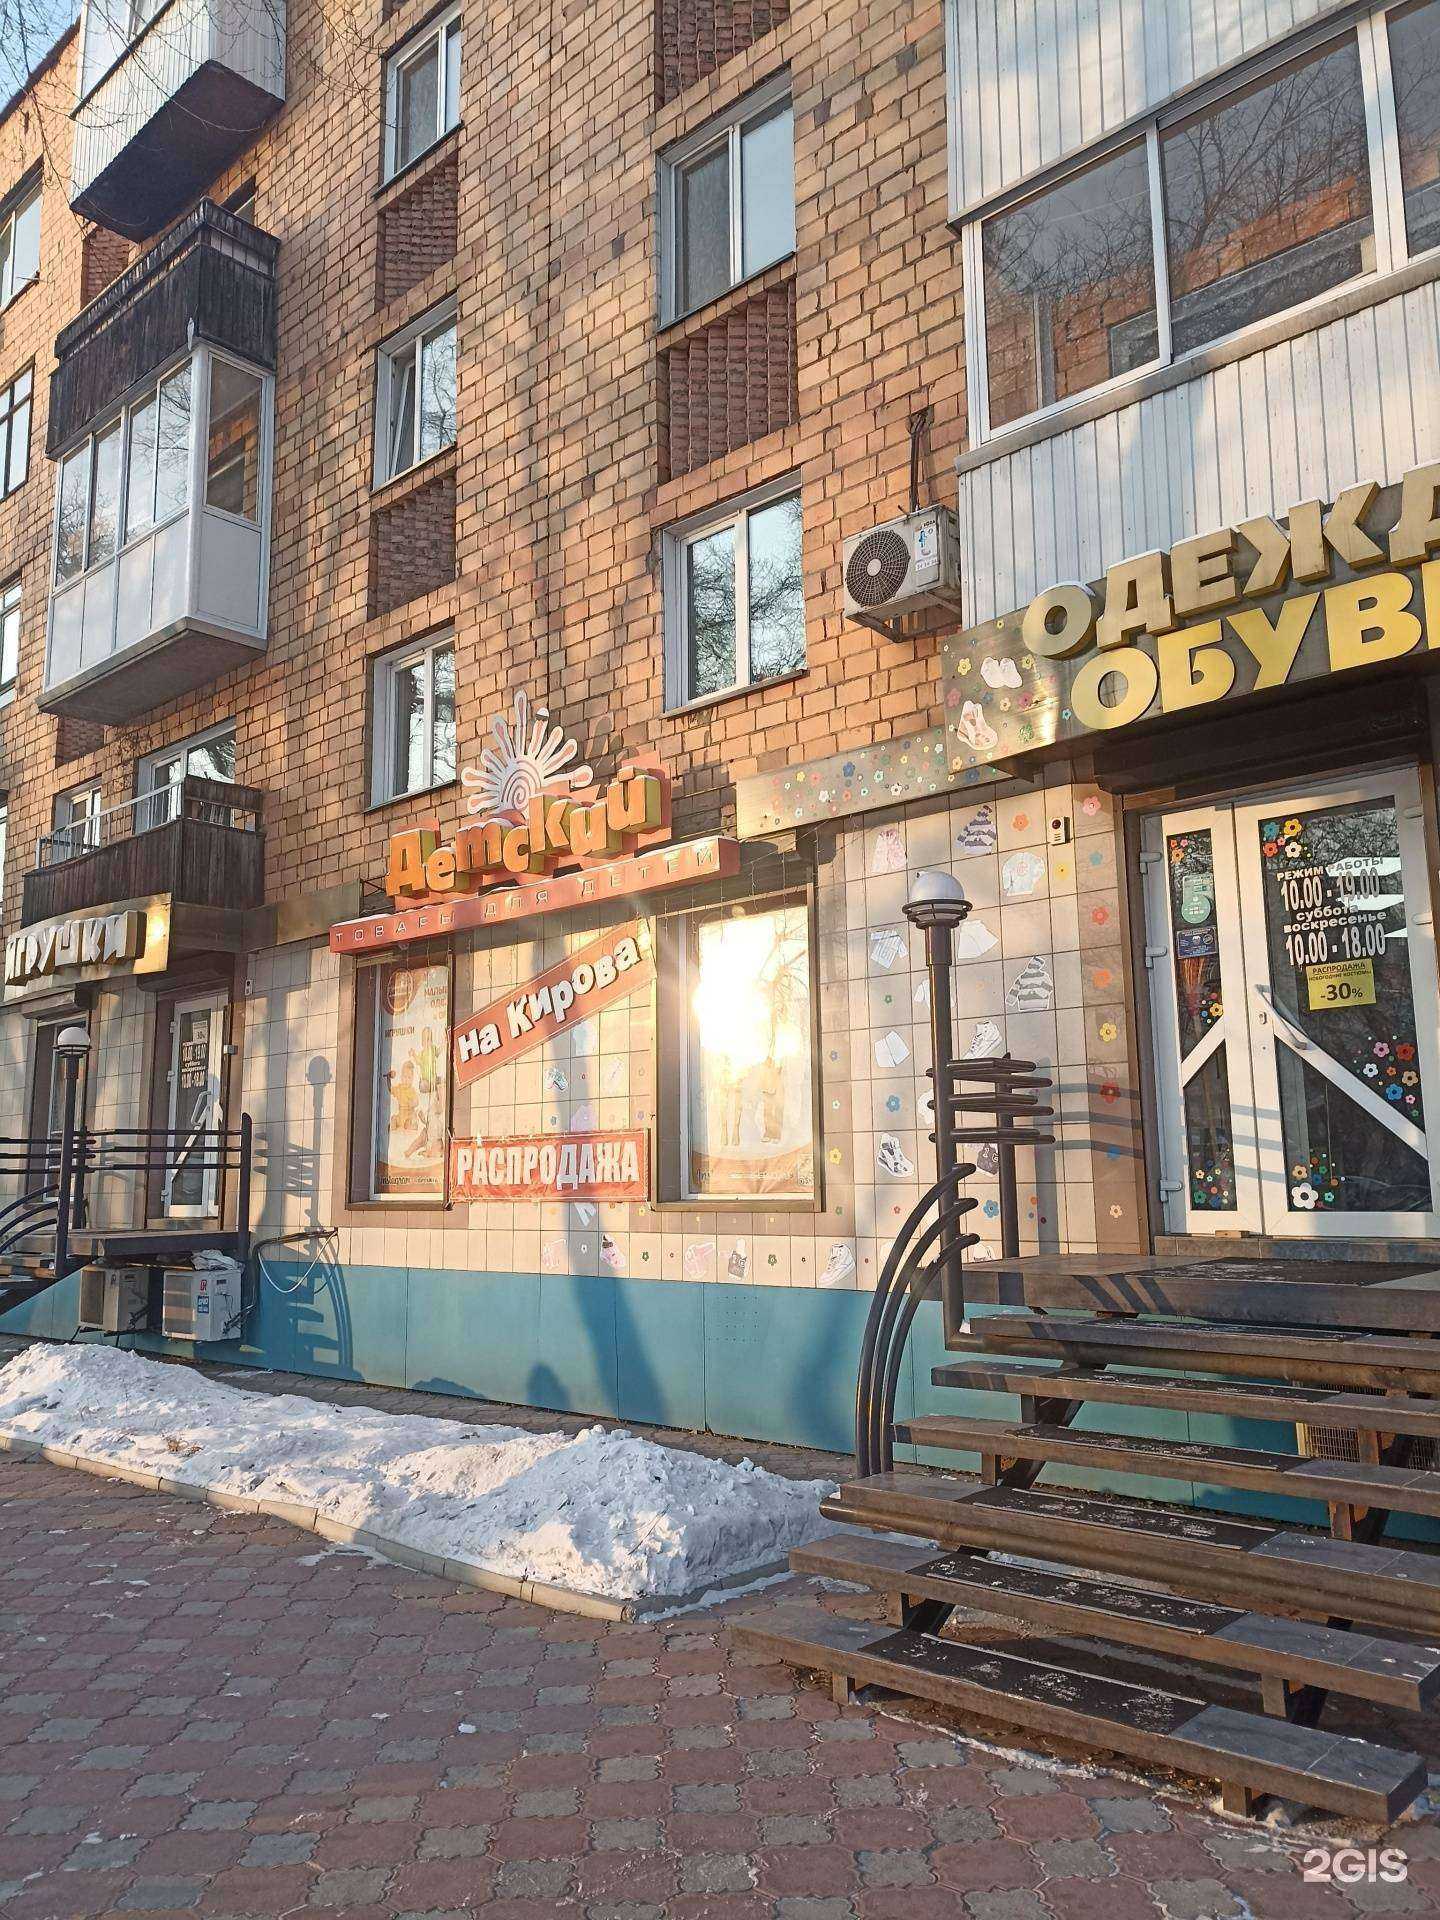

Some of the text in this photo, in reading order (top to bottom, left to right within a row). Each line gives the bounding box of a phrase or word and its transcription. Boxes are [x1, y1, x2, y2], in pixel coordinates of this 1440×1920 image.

[1071, 560, 1440, 730] ОБУВ
[385, 765, 661, 897] Детский
[1276, 857, 1384, 881] РЕЖИМ РАБОТЫ
[1281, 876, 1323, 911] 10.00
[1336, 867, 1380, 902] 19.00
[335, 847, 714, 945] ТОВАРЫ ДЛЯ ДЕТЕЙ
[1296, 905, 1359, 922] суббота
[1283, 912, 1387, 933] воскресенье
[1286, 931, 1328, 966] 10.00
[1341, 923, 1386, 959] 18.00
[1312, 963, 1366, 975] РАСПРОДАЖА
[458, 937, 642, 1063] На Кирова
[457, 1141, 640, 1191] РАСПРОДАЖА
